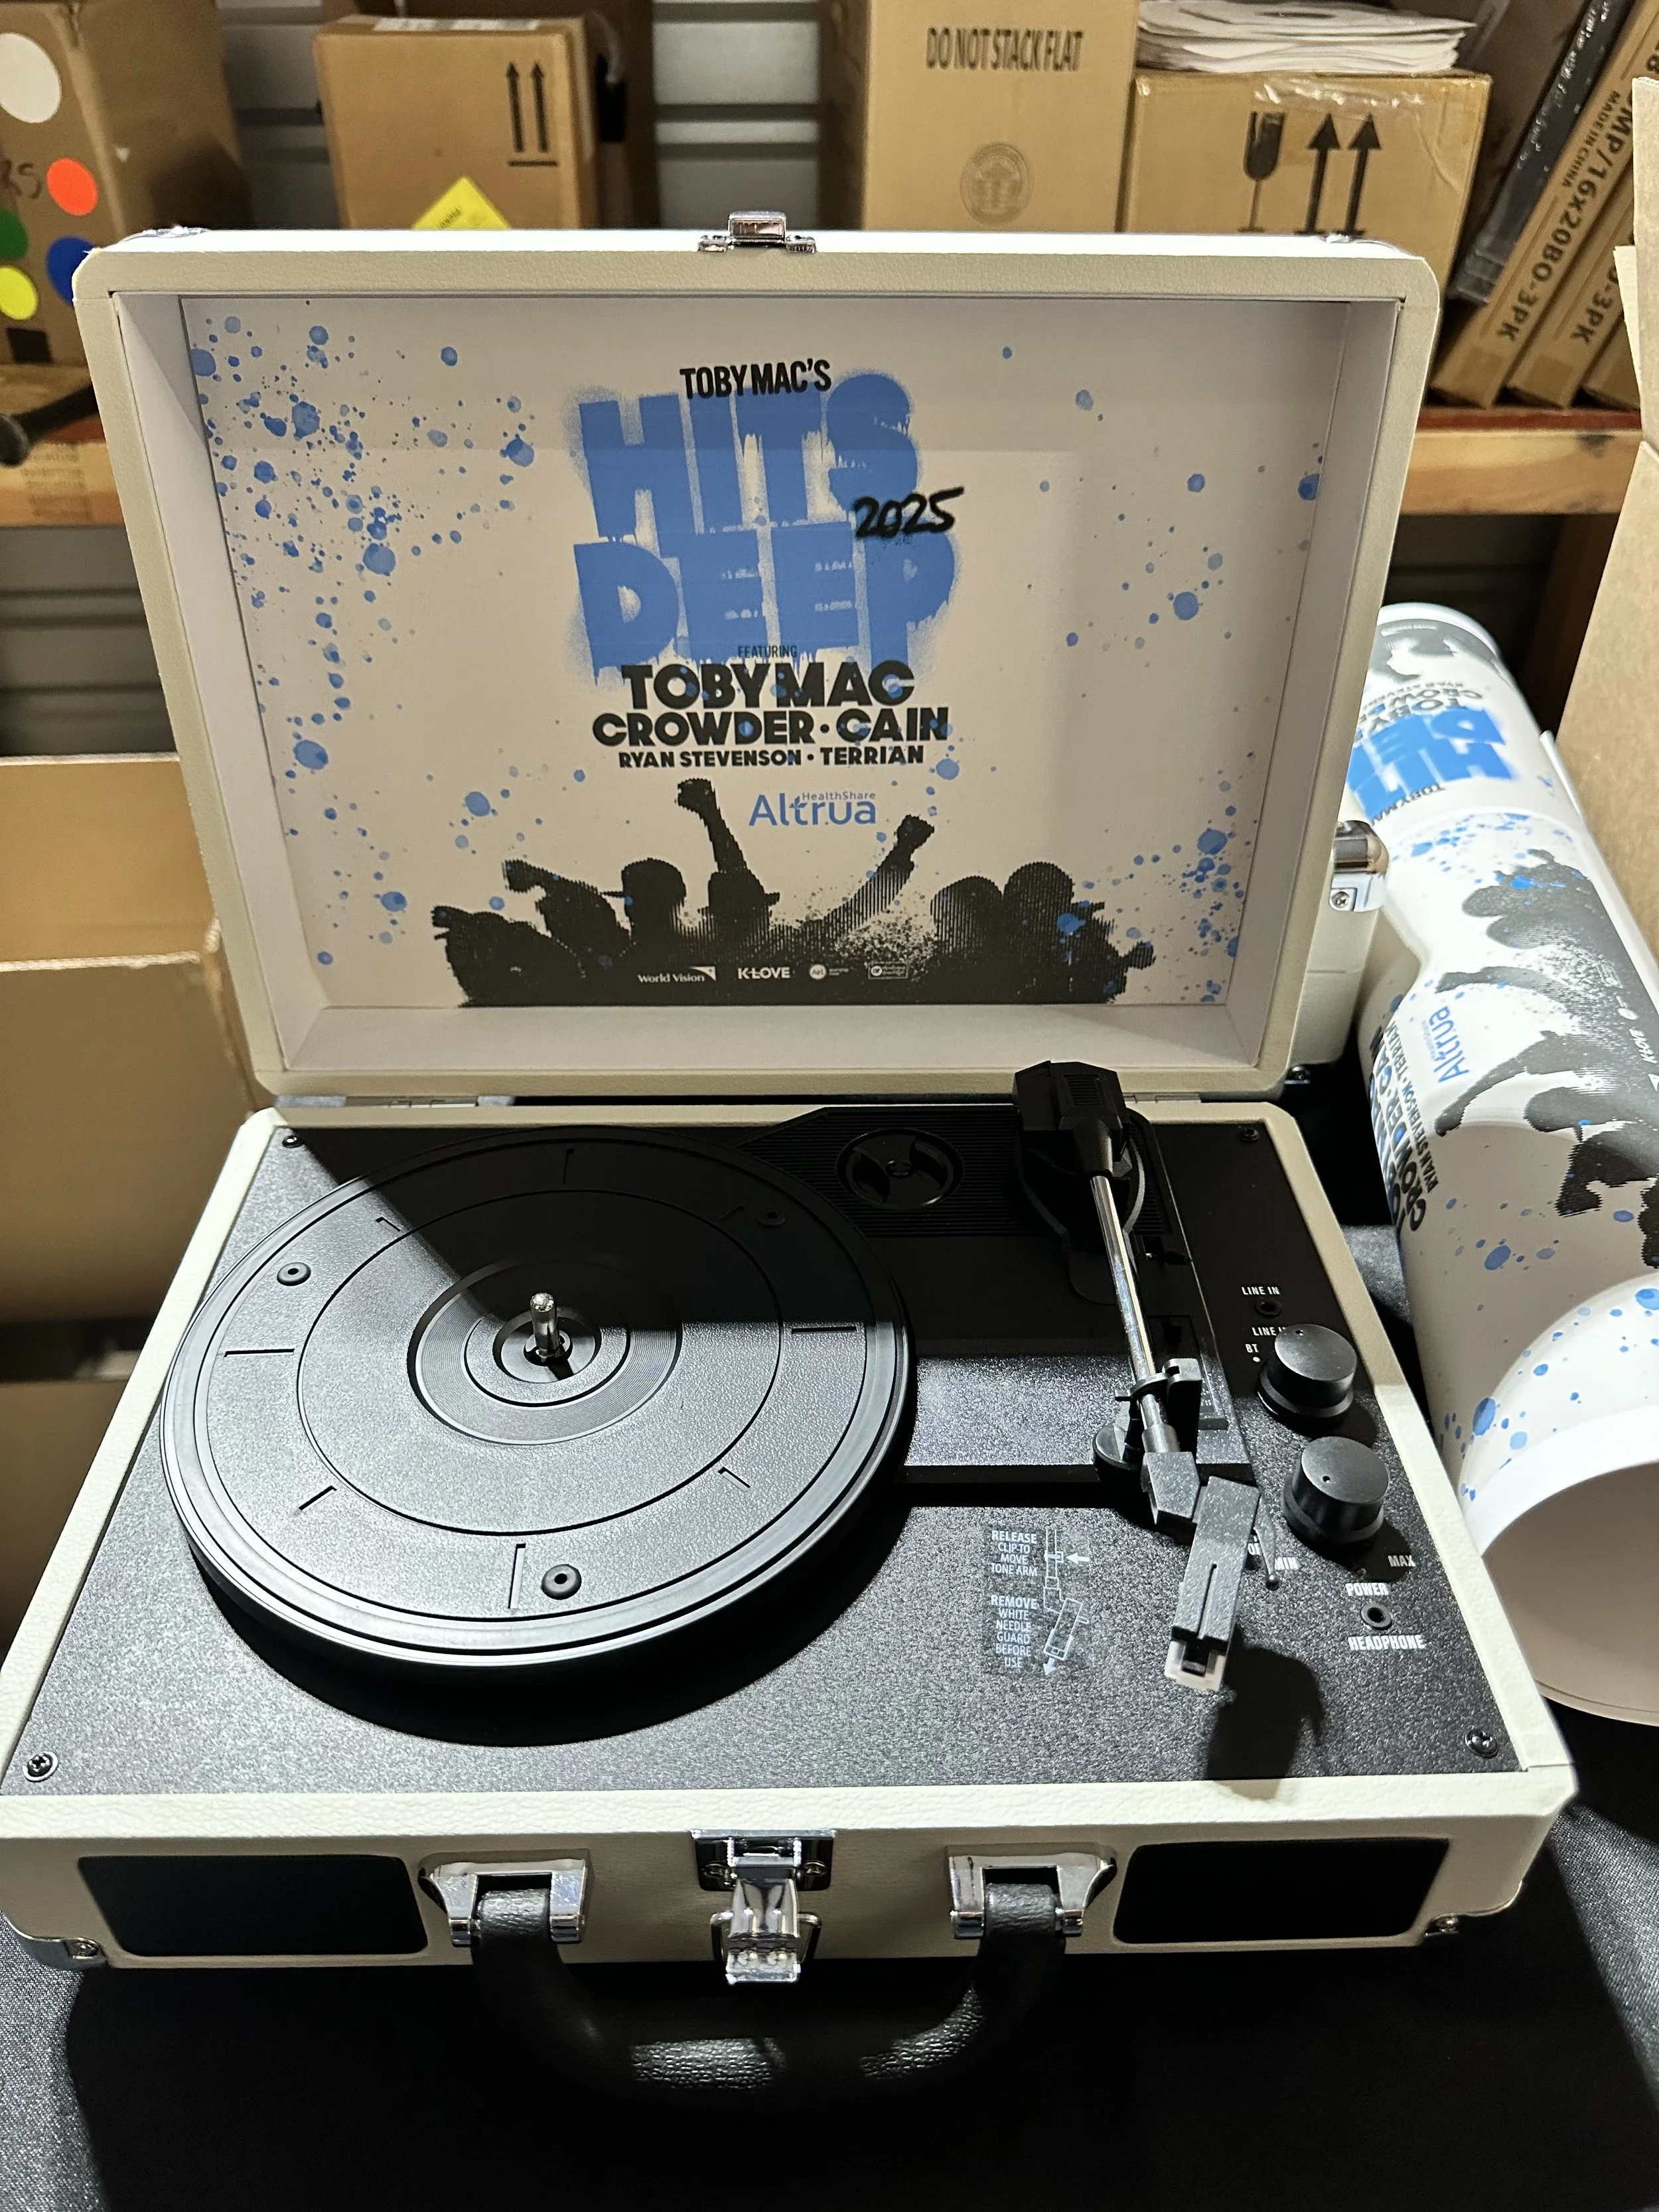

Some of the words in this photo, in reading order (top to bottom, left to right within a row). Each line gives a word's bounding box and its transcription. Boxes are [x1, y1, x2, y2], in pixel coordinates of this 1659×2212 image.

[926, 28, 952, 68] DO
[954, 28, 989, 69] NOT
[992, 29, 1044, 70] STACK
[1044, 29, 1086, 70] FLAT
[576, 373, 918, 540] HITS
[853, 486, 965, 539] 2025
[573, 515, 956, 677] DEEP
[738, 645, 797, 658] FEATURING
[621, 660, 915, 710] TOBYMAC
[592, 710, 816, 747] CROWDER
[835, 707, 949, 743] CAIN
[618, 751, 675, 769] RYAN
[680, 749, 802, 768] STEVENSON
[820, 745, 924, 766] TERRIAN
[802, 791, 876, 800] HealthShare
[749, 794, 876, 827] Altrua
[638, 974, 670, 983] World
[672, 973, 705, 982] Vision
[1429, 1005, 1470, 1083] Altrua
[1401, 1080, 1429, 1157] STEVENSON
[1386, 1088, 1426, 1232] CROWDER
[1419, 1149, 1439, 1194] RYAN
[1242, 1286, 1265, 1295] LINE
[1267, 1286, 1280, 1295] IN
[1252, 1327, 1277, 1337] LINE
[1245, 1344, 1259, 1353] BT
[992, 1530, 1037, 1544] RELEASE
[998, 1543, 1017, 1553] CLIP
[1018, 1544, 1031, 1554] TO
[1001, 1553, 1028, 1564] MOVE
[1388, 1555, 1416, 1567] MAX
[991, 1563, 1014, 1575] TONE
[1016, 1566, 1037, 1577] ARM
[1345, 1582, 1389, 1596] POWER
[991, 1595, 1037, 1610] REMOVE
[999, 1608, 1029, 1619] WHITE
[996, 1619, 1031, 1633] NEEDLE
[997, 1632, 1030, 1644] GUARD
[1347, 1635, 1426, 1651] HEADPHONE
[996, 1643, 1031, 1657] BEFORE
[1005, 1657, 1023, 1668] USE
